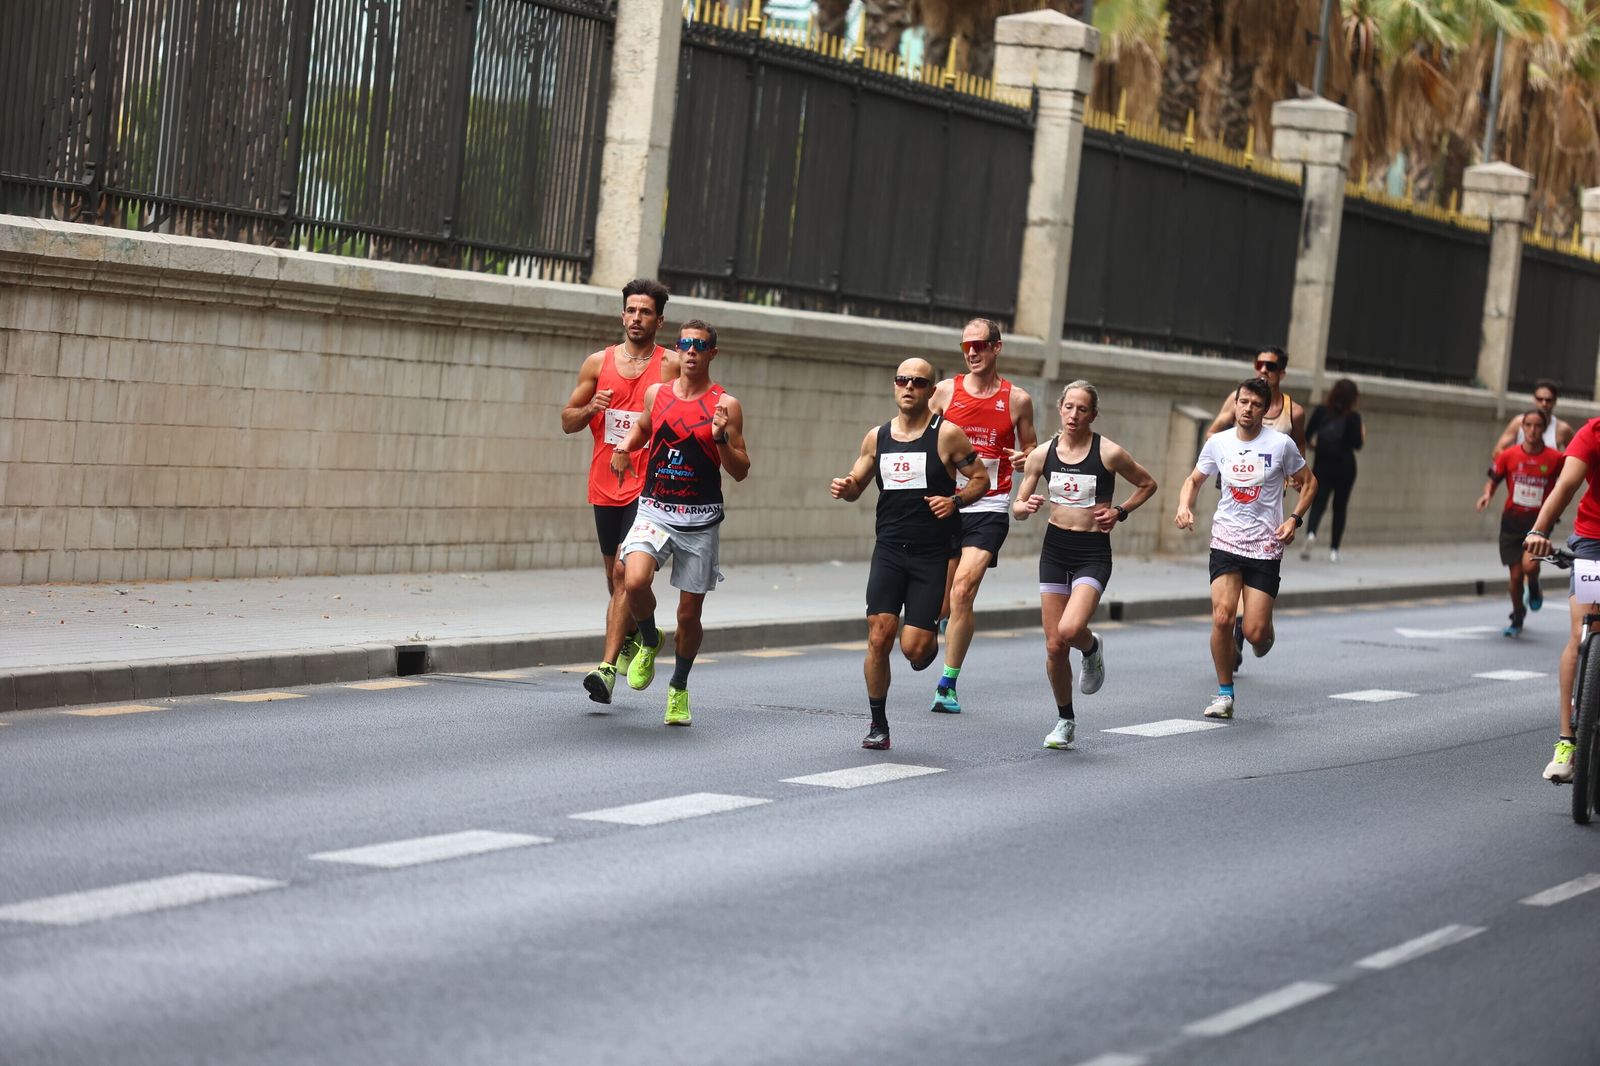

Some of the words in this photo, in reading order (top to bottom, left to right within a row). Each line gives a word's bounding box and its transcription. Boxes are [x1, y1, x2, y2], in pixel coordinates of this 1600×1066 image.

[893, 461, 910, 472] 78
[1232, 464, 1255, 473] 620
[657, 467, 694, 478] HARMAN
[1063, 482, 1079, 493] 21
